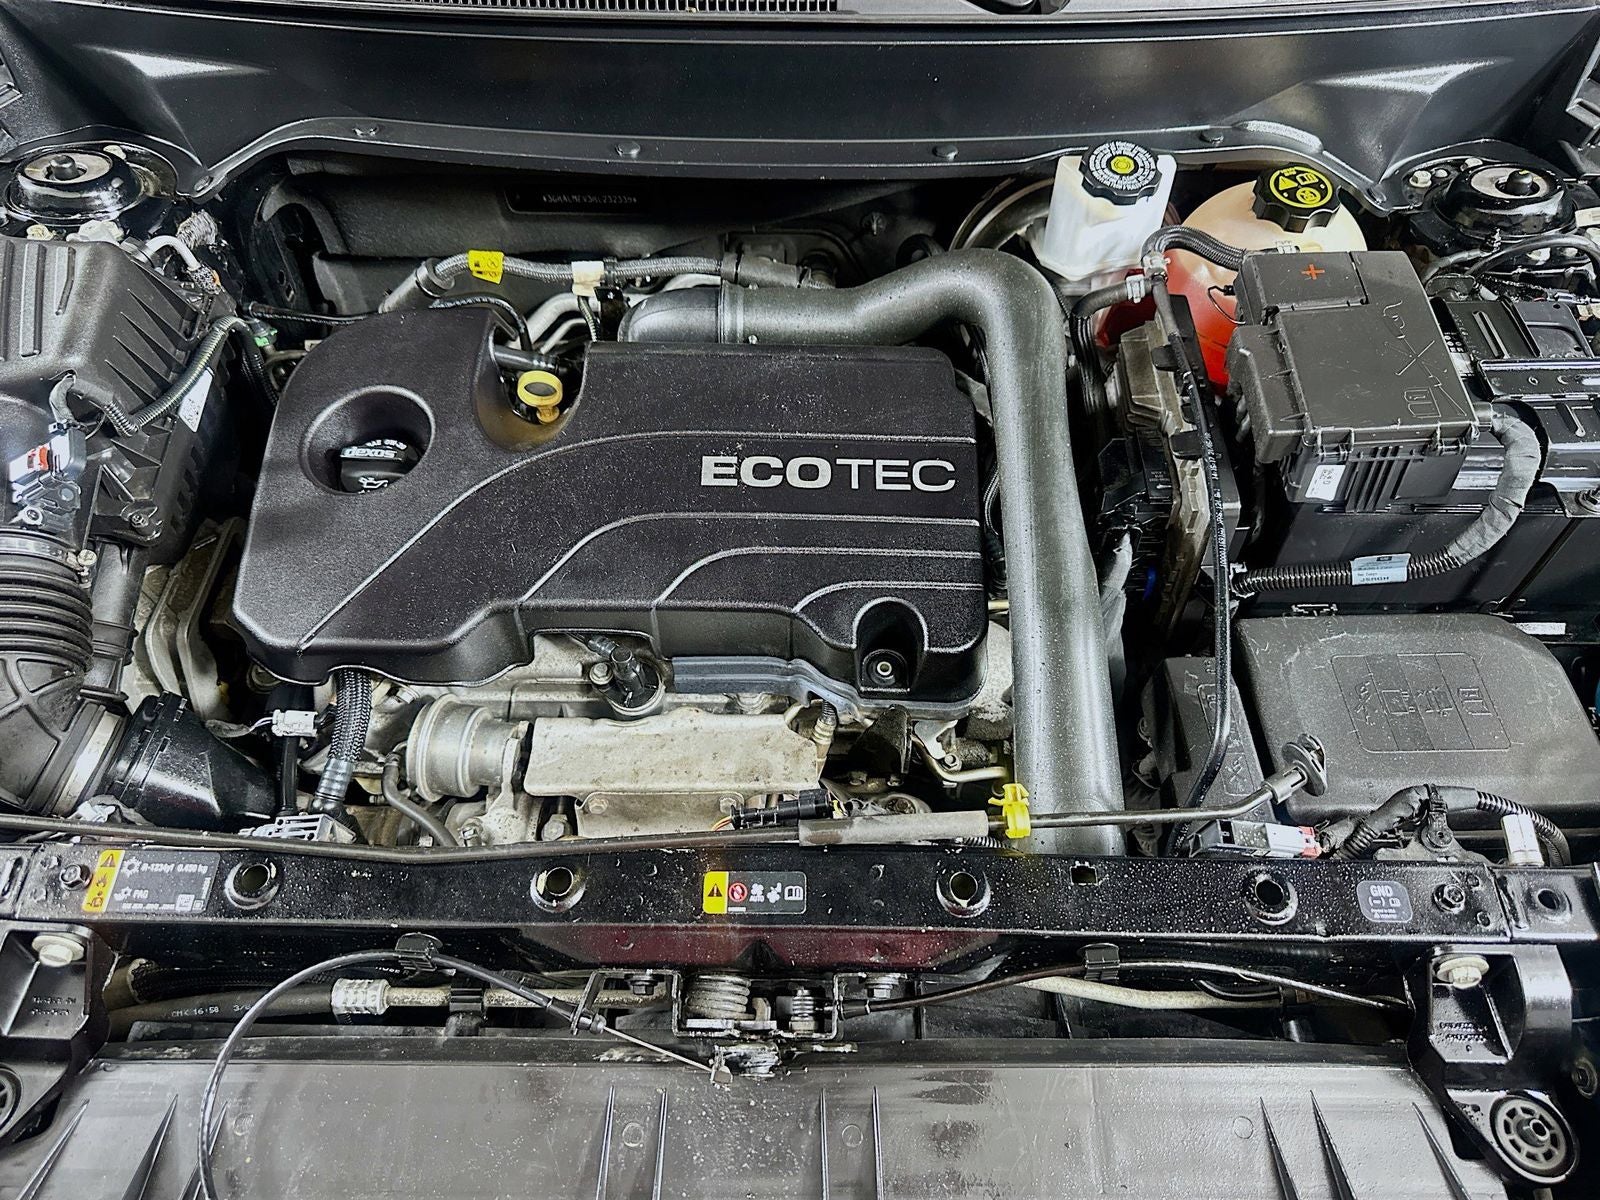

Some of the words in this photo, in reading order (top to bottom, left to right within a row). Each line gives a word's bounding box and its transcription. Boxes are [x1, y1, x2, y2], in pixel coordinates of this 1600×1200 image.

[343, 446, 398, 459] dexos
[700, 455, 956, 492] ECOTEC
[1370, 885, 1394, 898] GND
